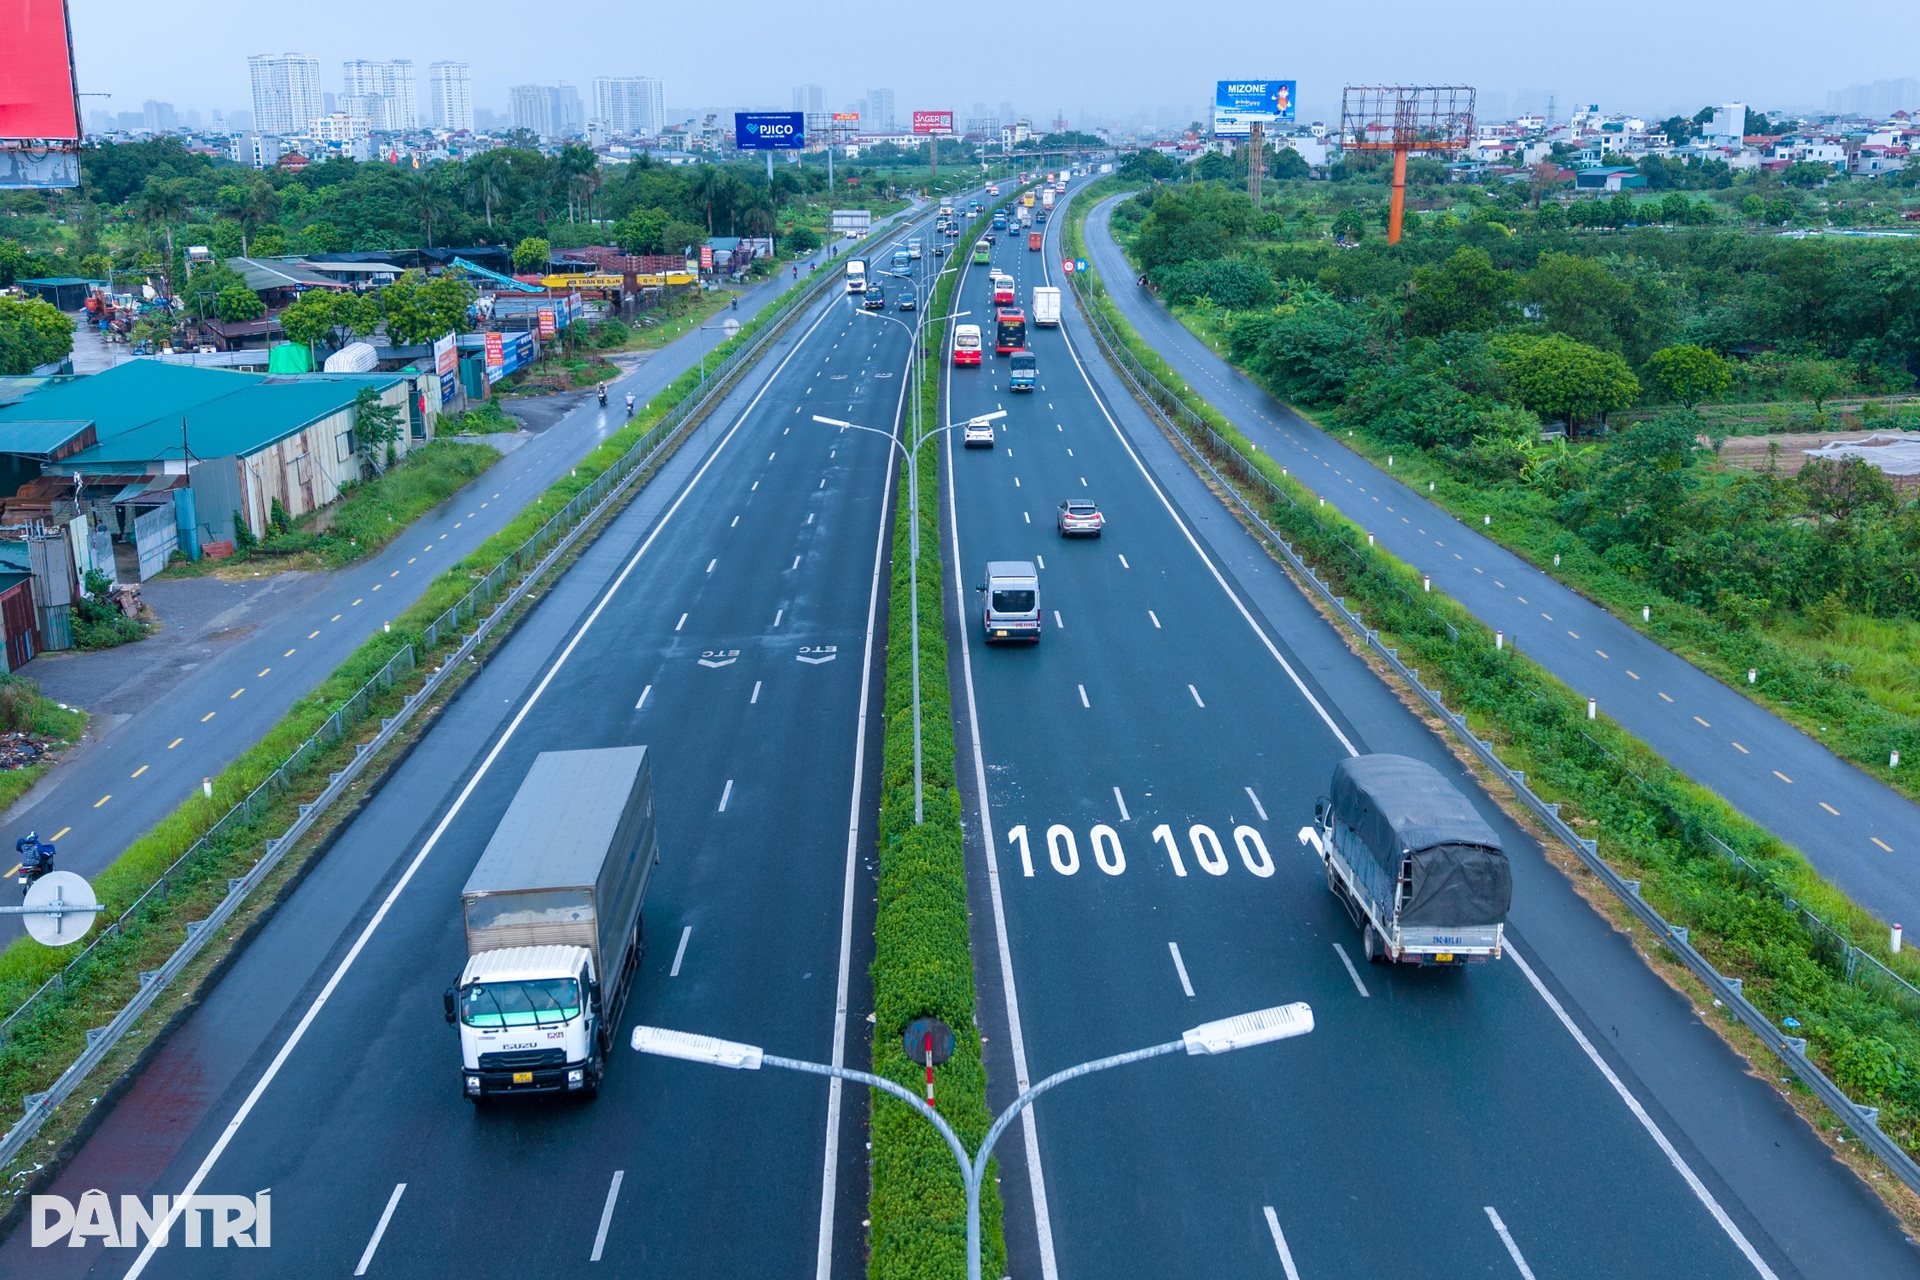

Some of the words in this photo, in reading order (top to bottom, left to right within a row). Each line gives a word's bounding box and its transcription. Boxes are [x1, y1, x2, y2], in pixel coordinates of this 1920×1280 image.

[1228, 84, 1266, 93] MIZONE
[759, 125, 793, 135] PJICO
[701, 649, 741, 658] ETC
[799, 645, 837, 653] ETC
[1008, 824, 1126, 877] 100
[1152, 824, 1276, 878] 100
[502, 1042, 538, 1050] ISUZU
